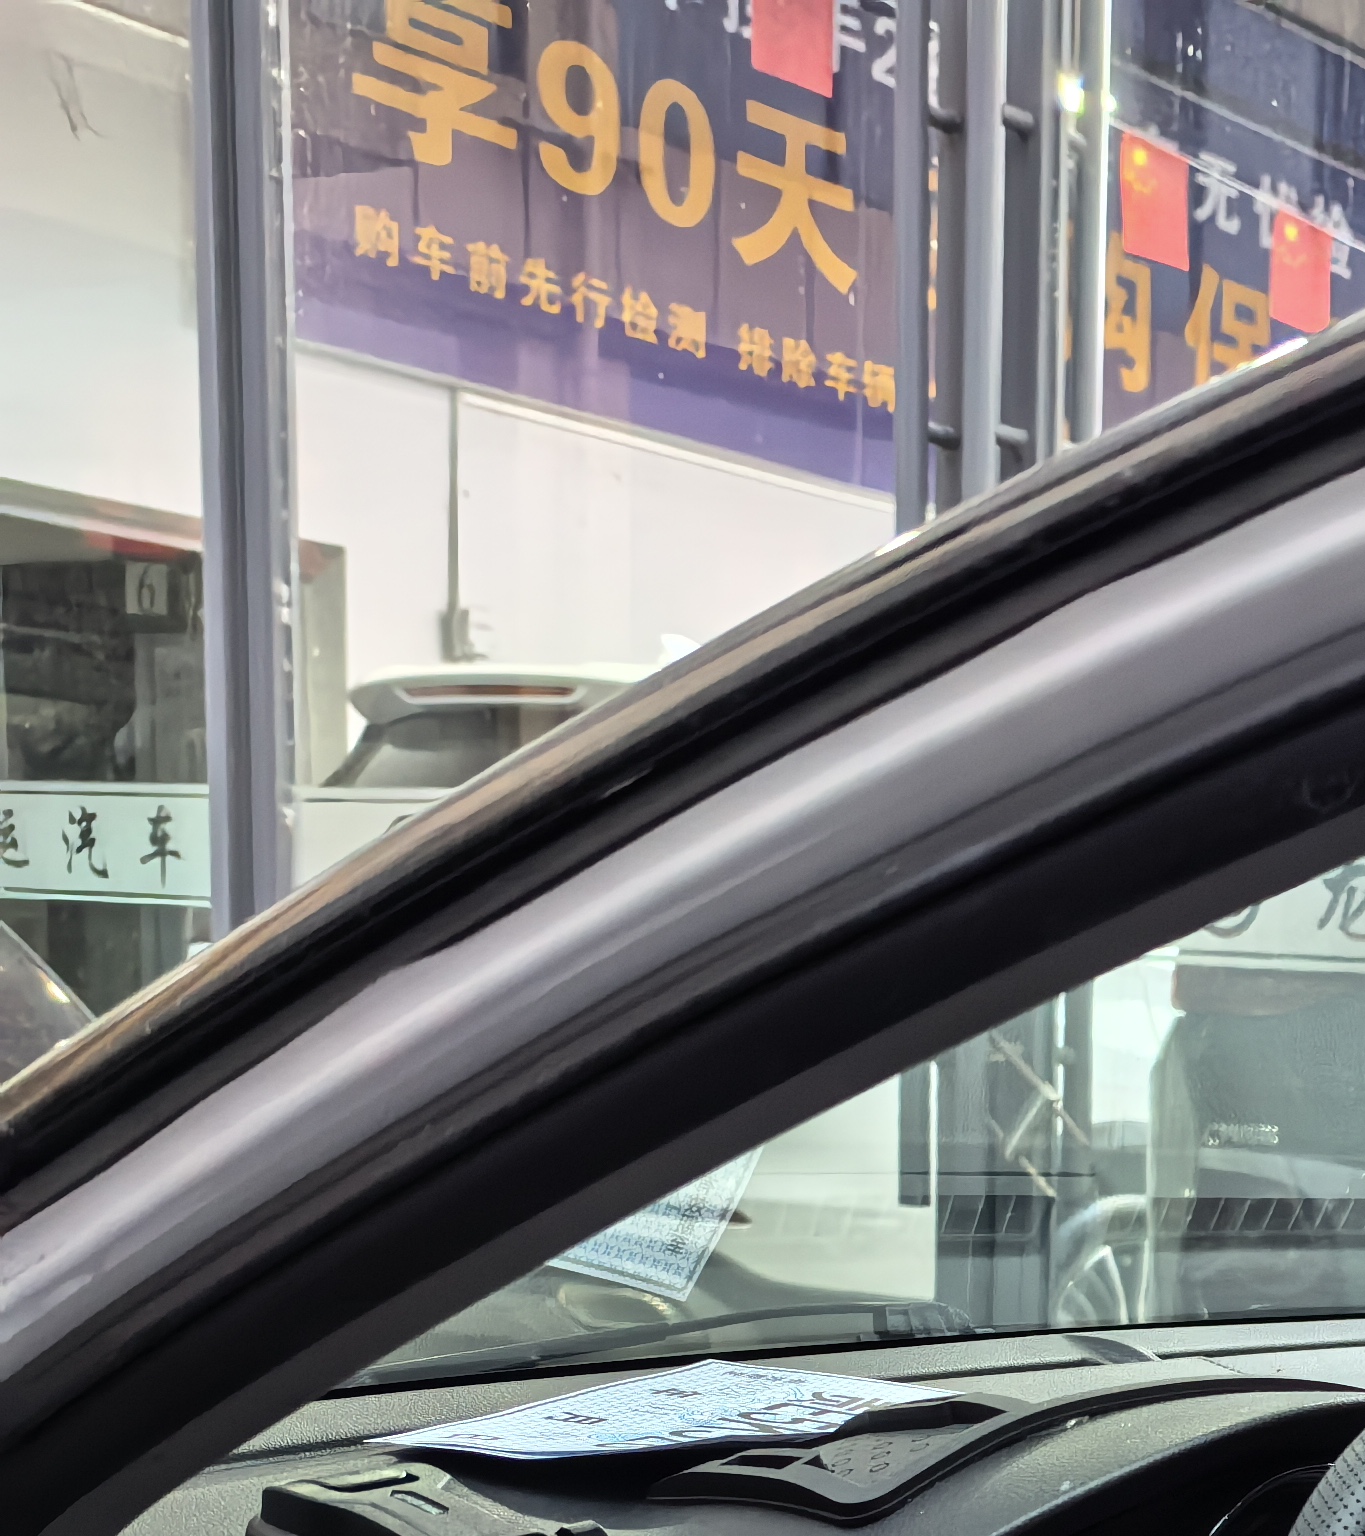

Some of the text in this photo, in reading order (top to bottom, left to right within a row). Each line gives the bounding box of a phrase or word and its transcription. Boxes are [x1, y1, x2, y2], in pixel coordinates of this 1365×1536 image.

[353, 204, 707, 358] 购车前先行检测
